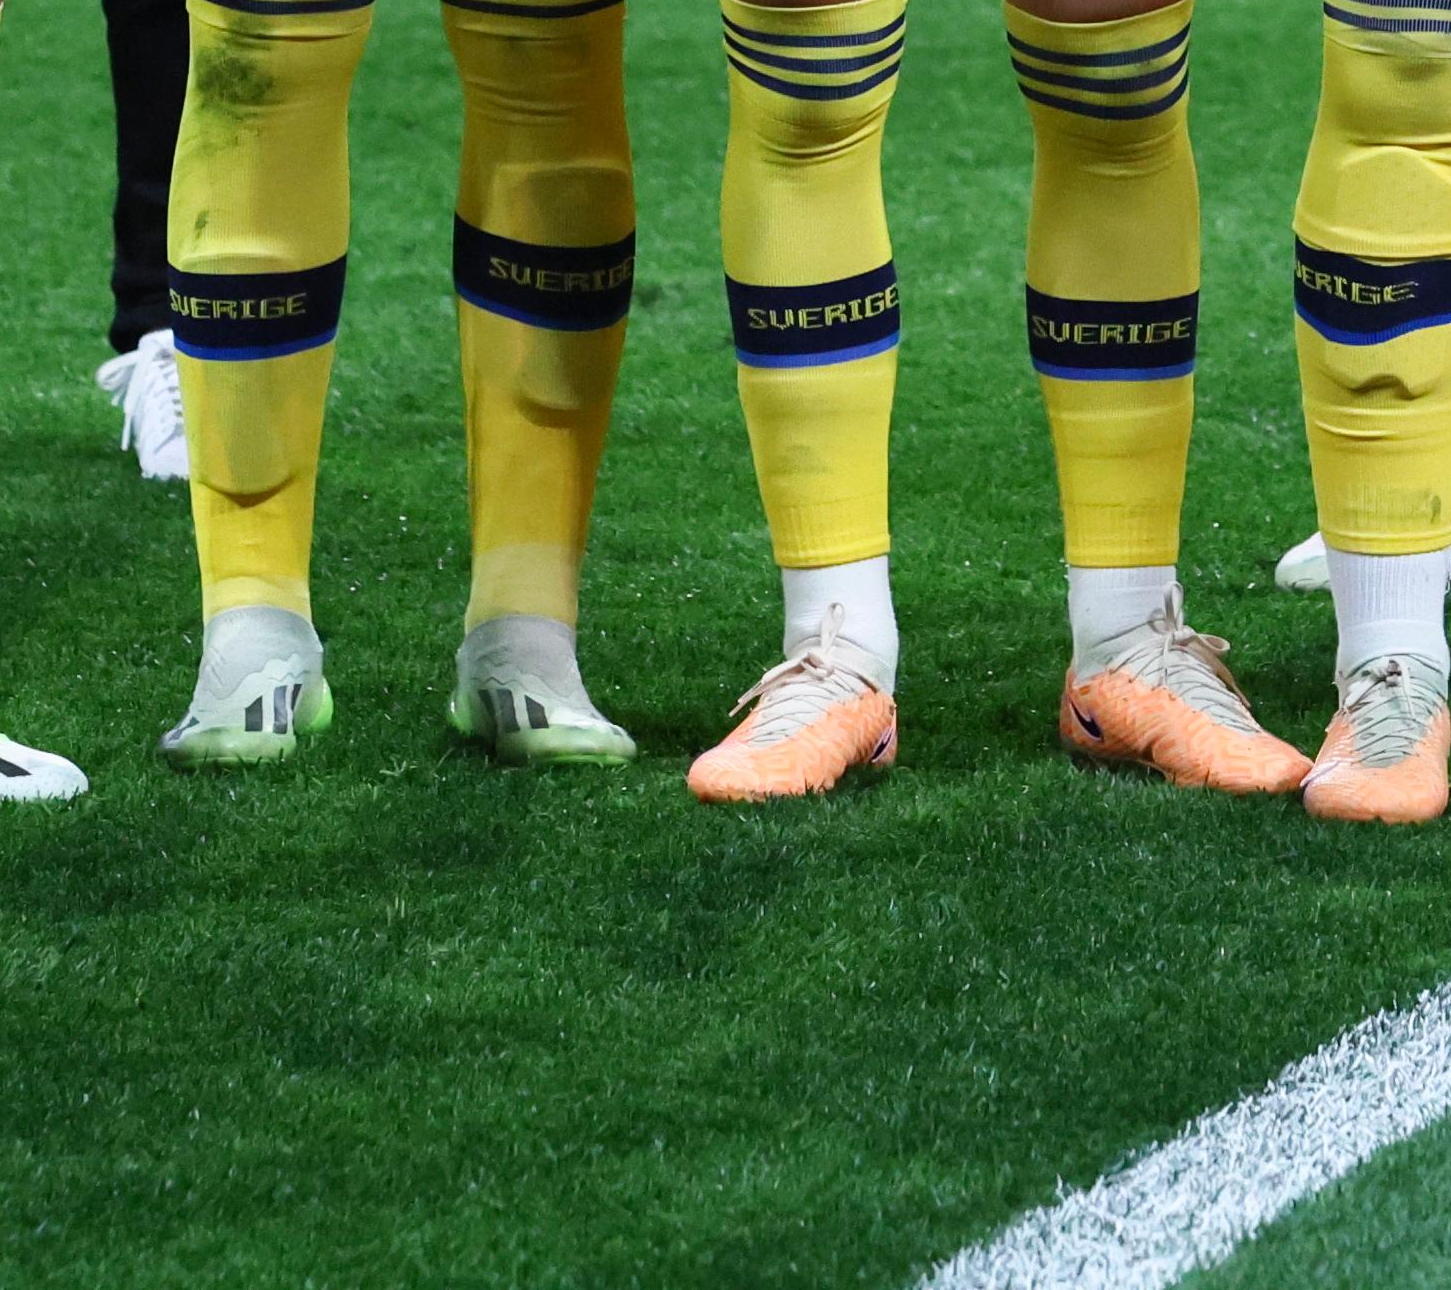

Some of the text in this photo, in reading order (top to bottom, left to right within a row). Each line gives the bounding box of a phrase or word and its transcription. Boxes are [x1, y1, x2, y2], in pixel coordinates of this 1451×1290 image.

[169, 288, 307, 319] SVERIGE
[748, 285, 900, 330] SVERIGE
[1032, 316, 1191, 346] SVERIGE
